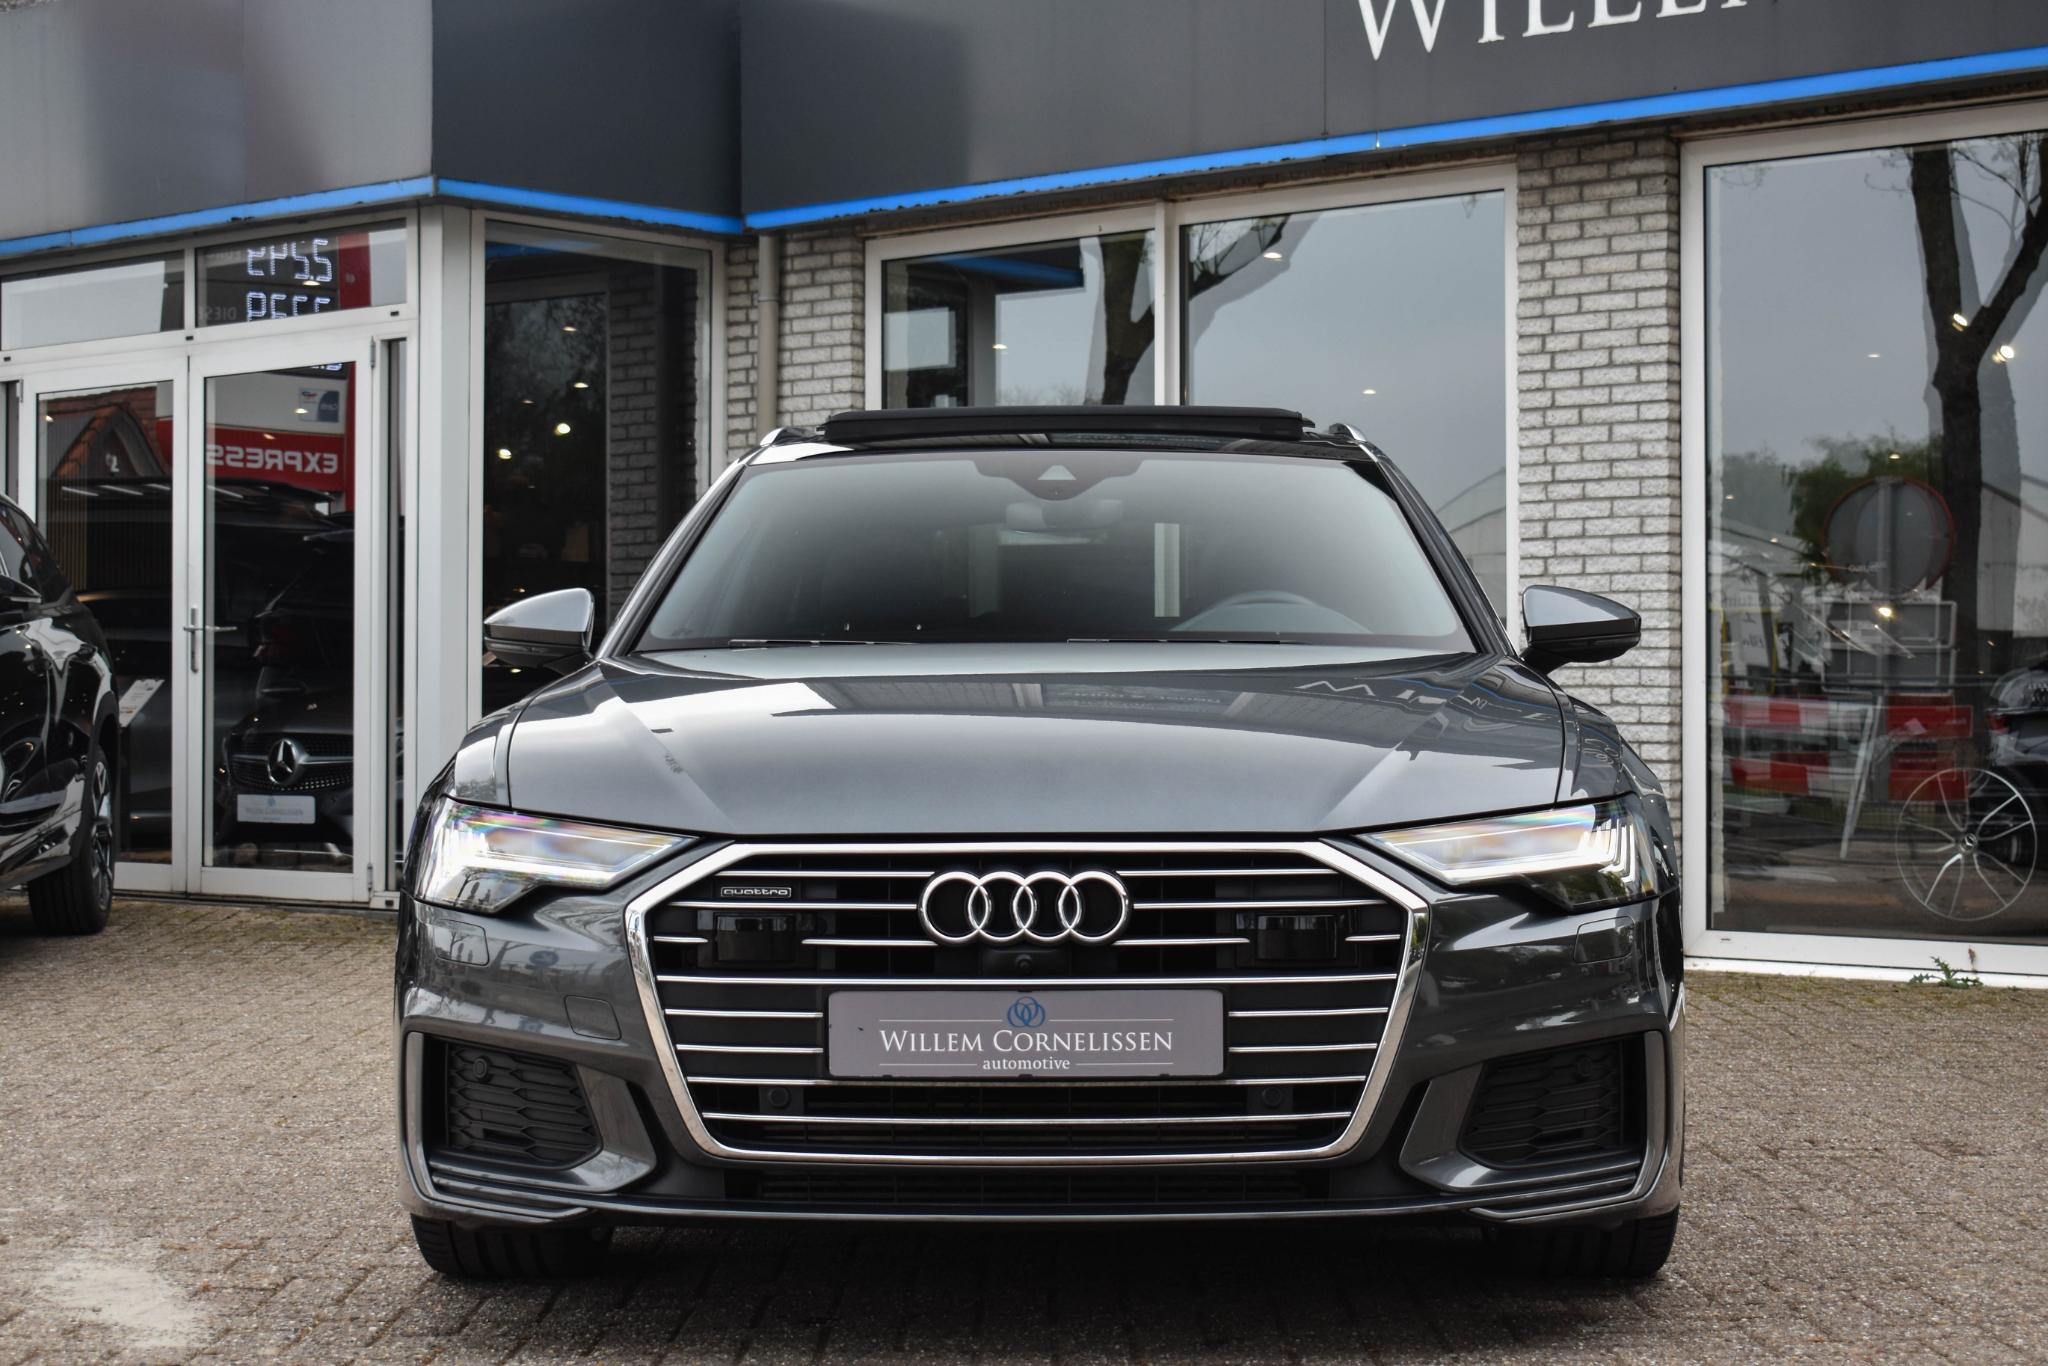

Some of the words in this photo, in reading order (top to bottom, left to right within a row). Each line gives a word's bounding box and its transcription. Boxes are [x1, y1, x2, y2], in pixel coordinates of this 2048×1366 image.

[1357, 0, 1748, 61] WIL
[723, 888, 788, 896] quattro
[879, 1030, 983, 1052] WILLEM
[993, 1030, 1173, 1052] CORNELISSEN
[983, 1058, 1071, 1070] automotive
